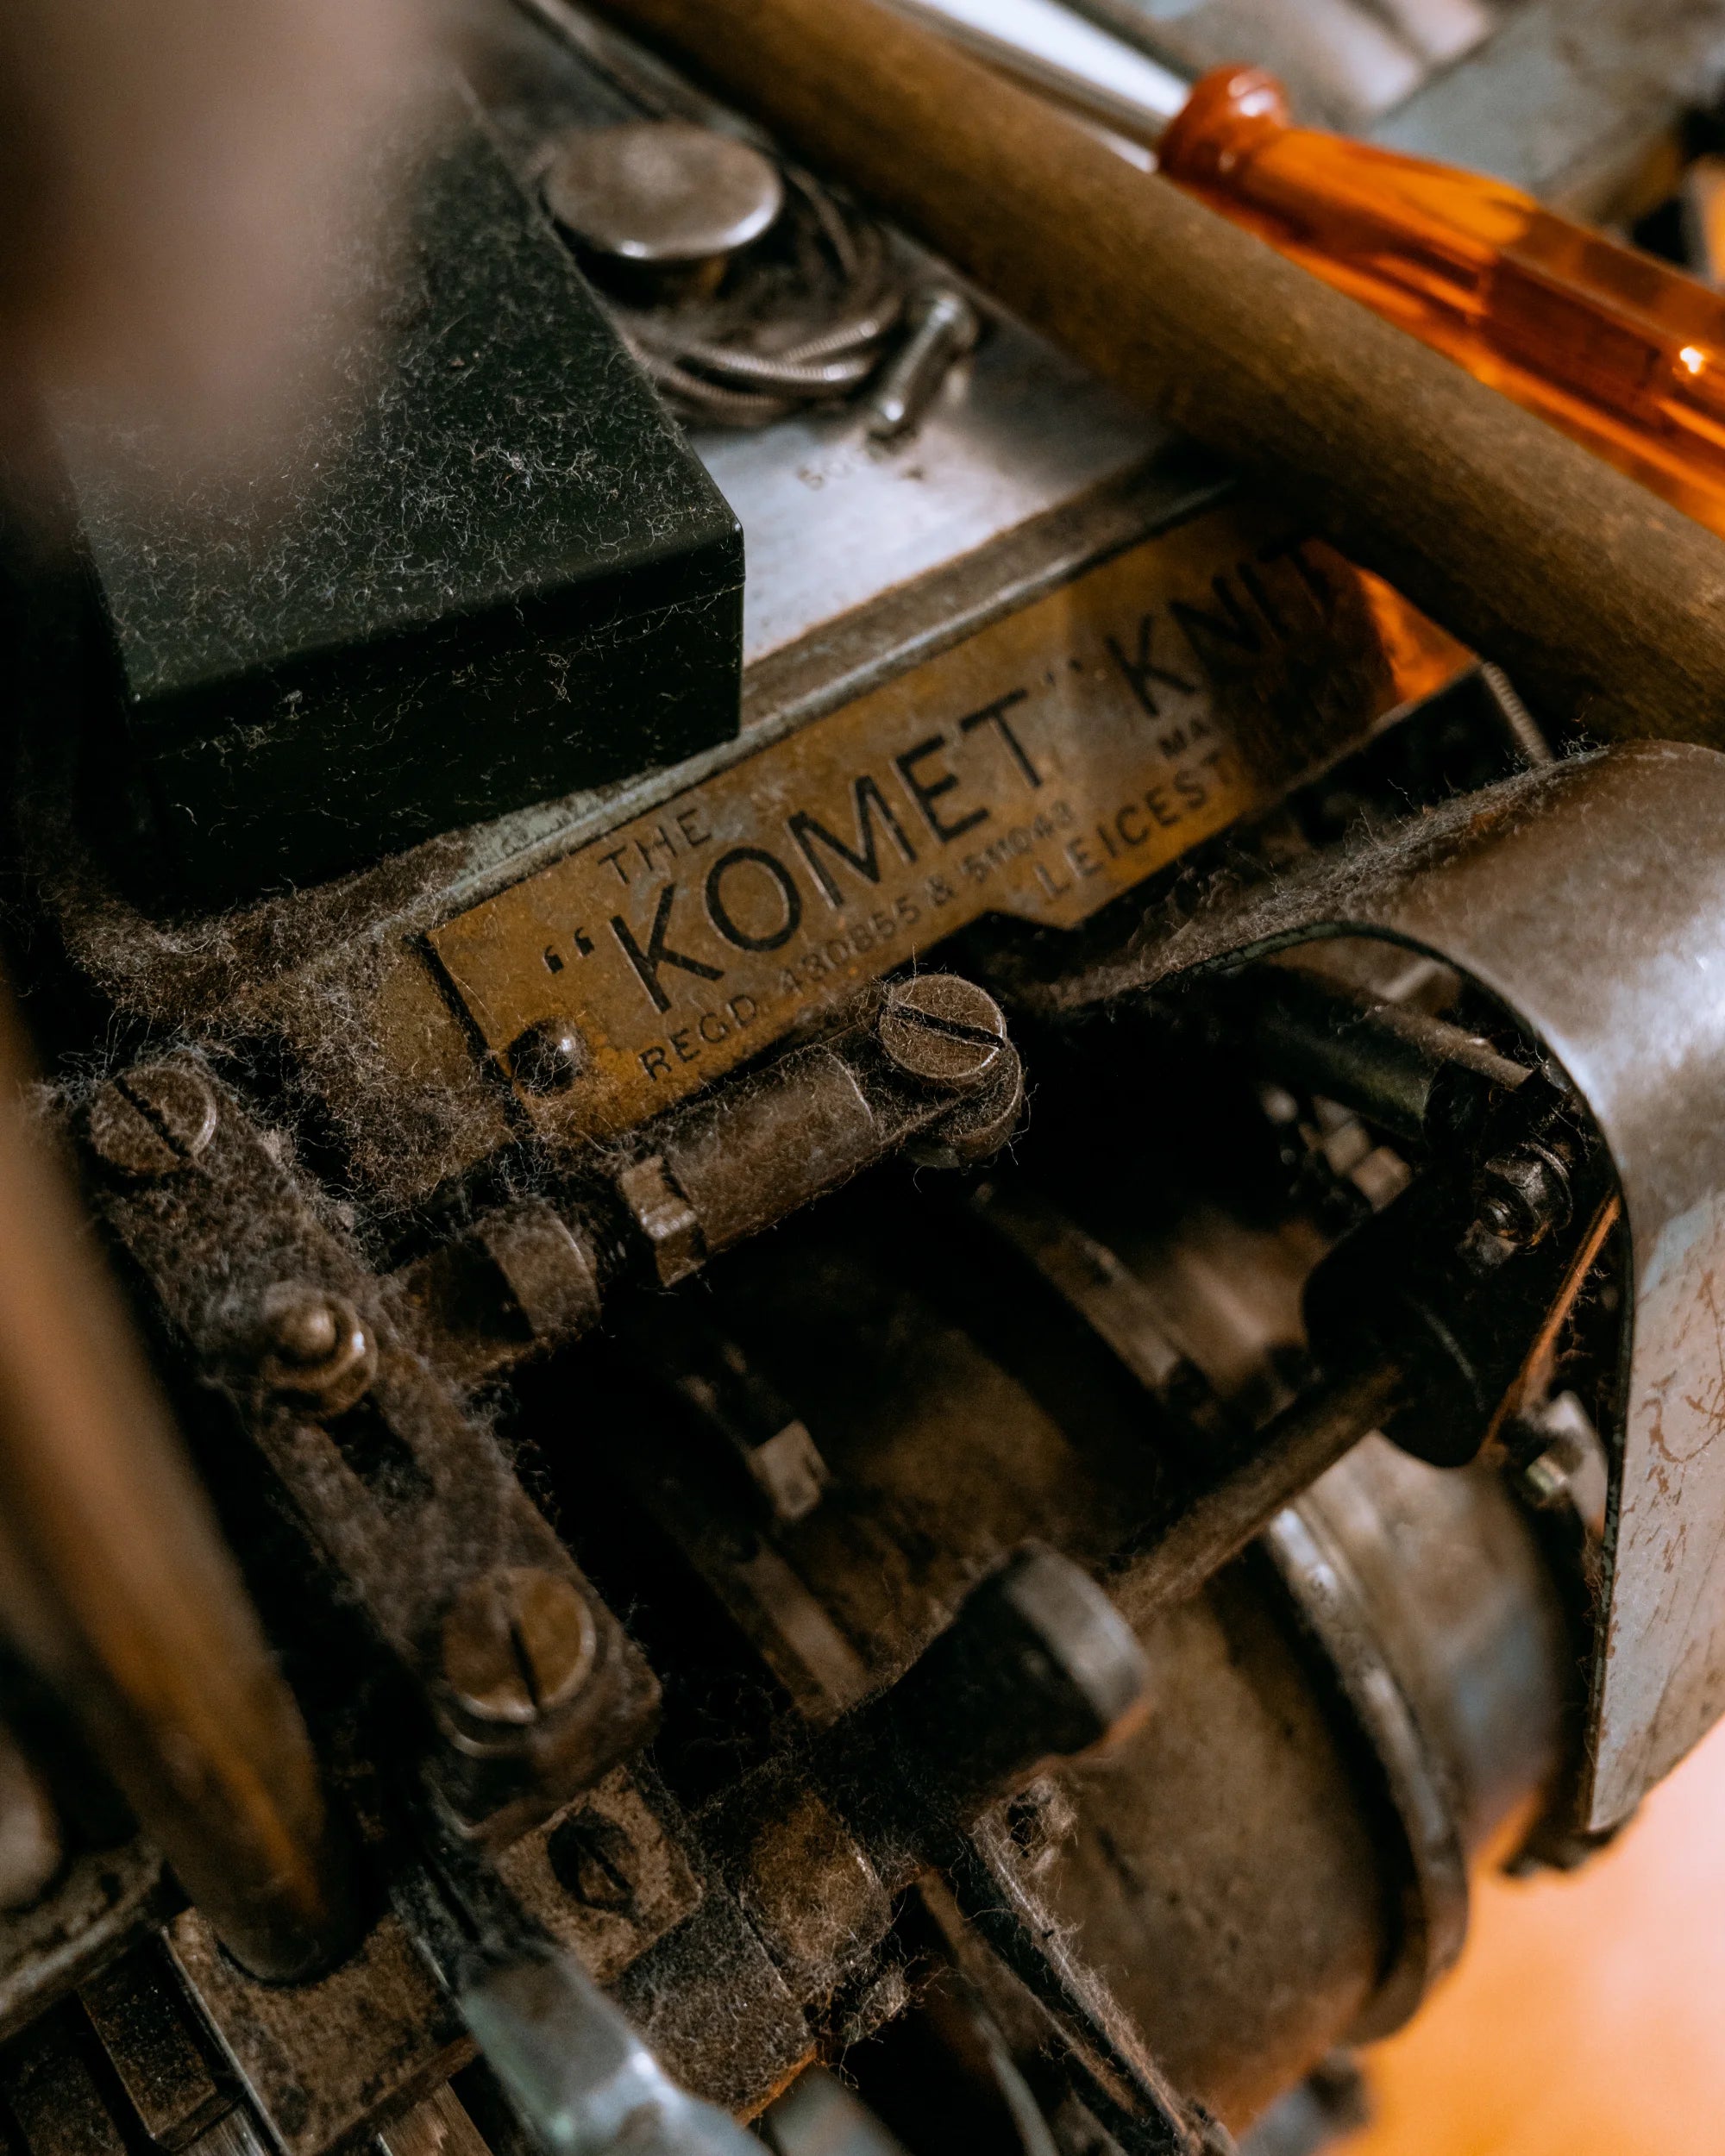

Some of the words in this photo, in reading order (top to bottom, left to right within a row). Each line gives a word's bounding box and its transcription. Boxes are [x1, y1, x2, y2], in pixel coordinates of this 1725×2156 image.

[596, 807, 712, 887] THE
[1033, 753, 1233, 899] LEICEST
[925, 871, 957, 906] &
